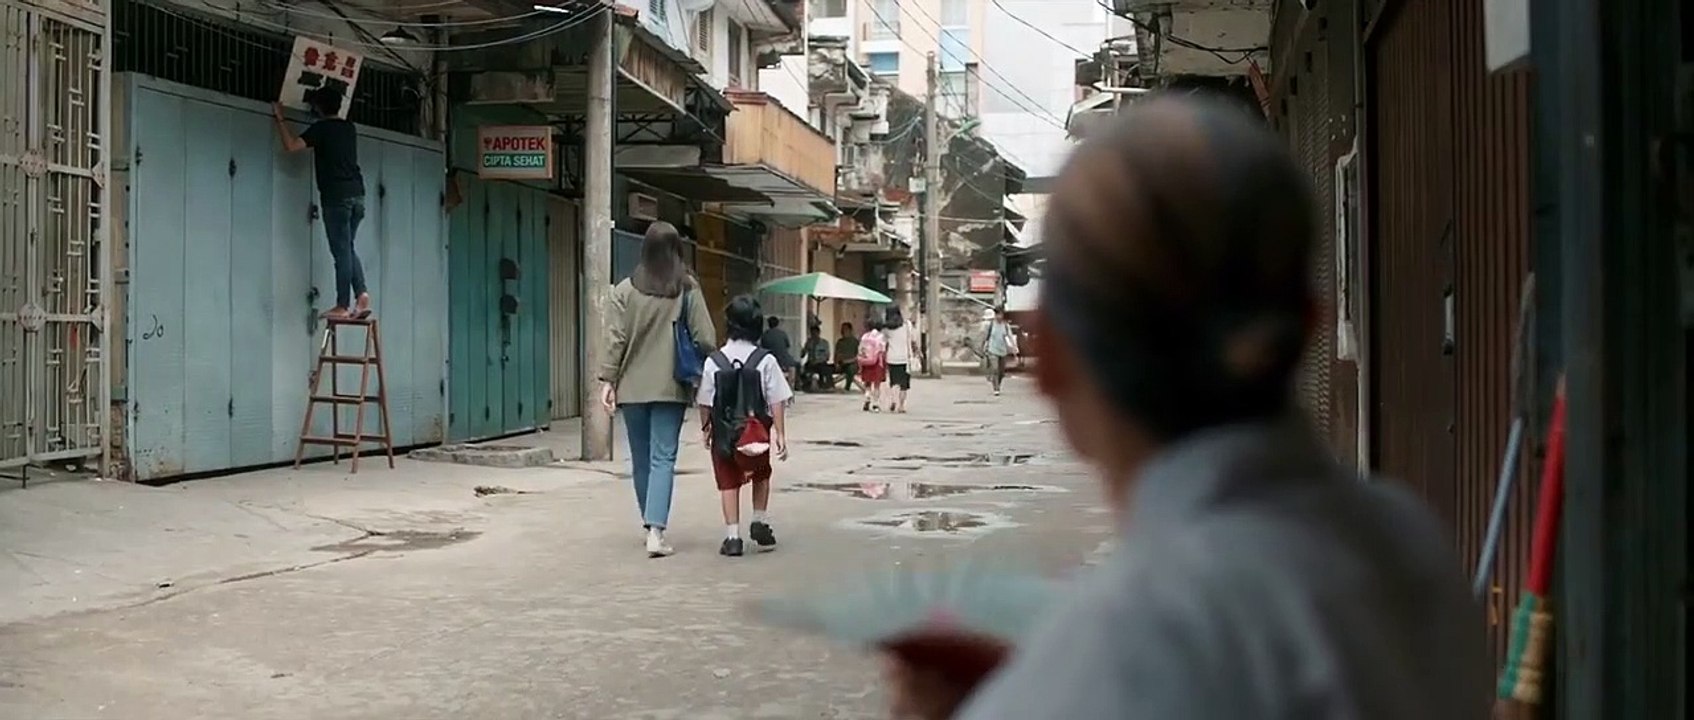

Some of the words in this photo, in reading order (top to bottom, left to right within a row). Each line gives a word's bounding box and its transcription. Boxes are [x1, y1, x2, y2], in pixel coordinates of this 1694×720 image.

[493, 136, 545, 150] APOTEK
[484, 155, 512, 166] CIPTA
[513, 155, 544, 166] SEHAT
